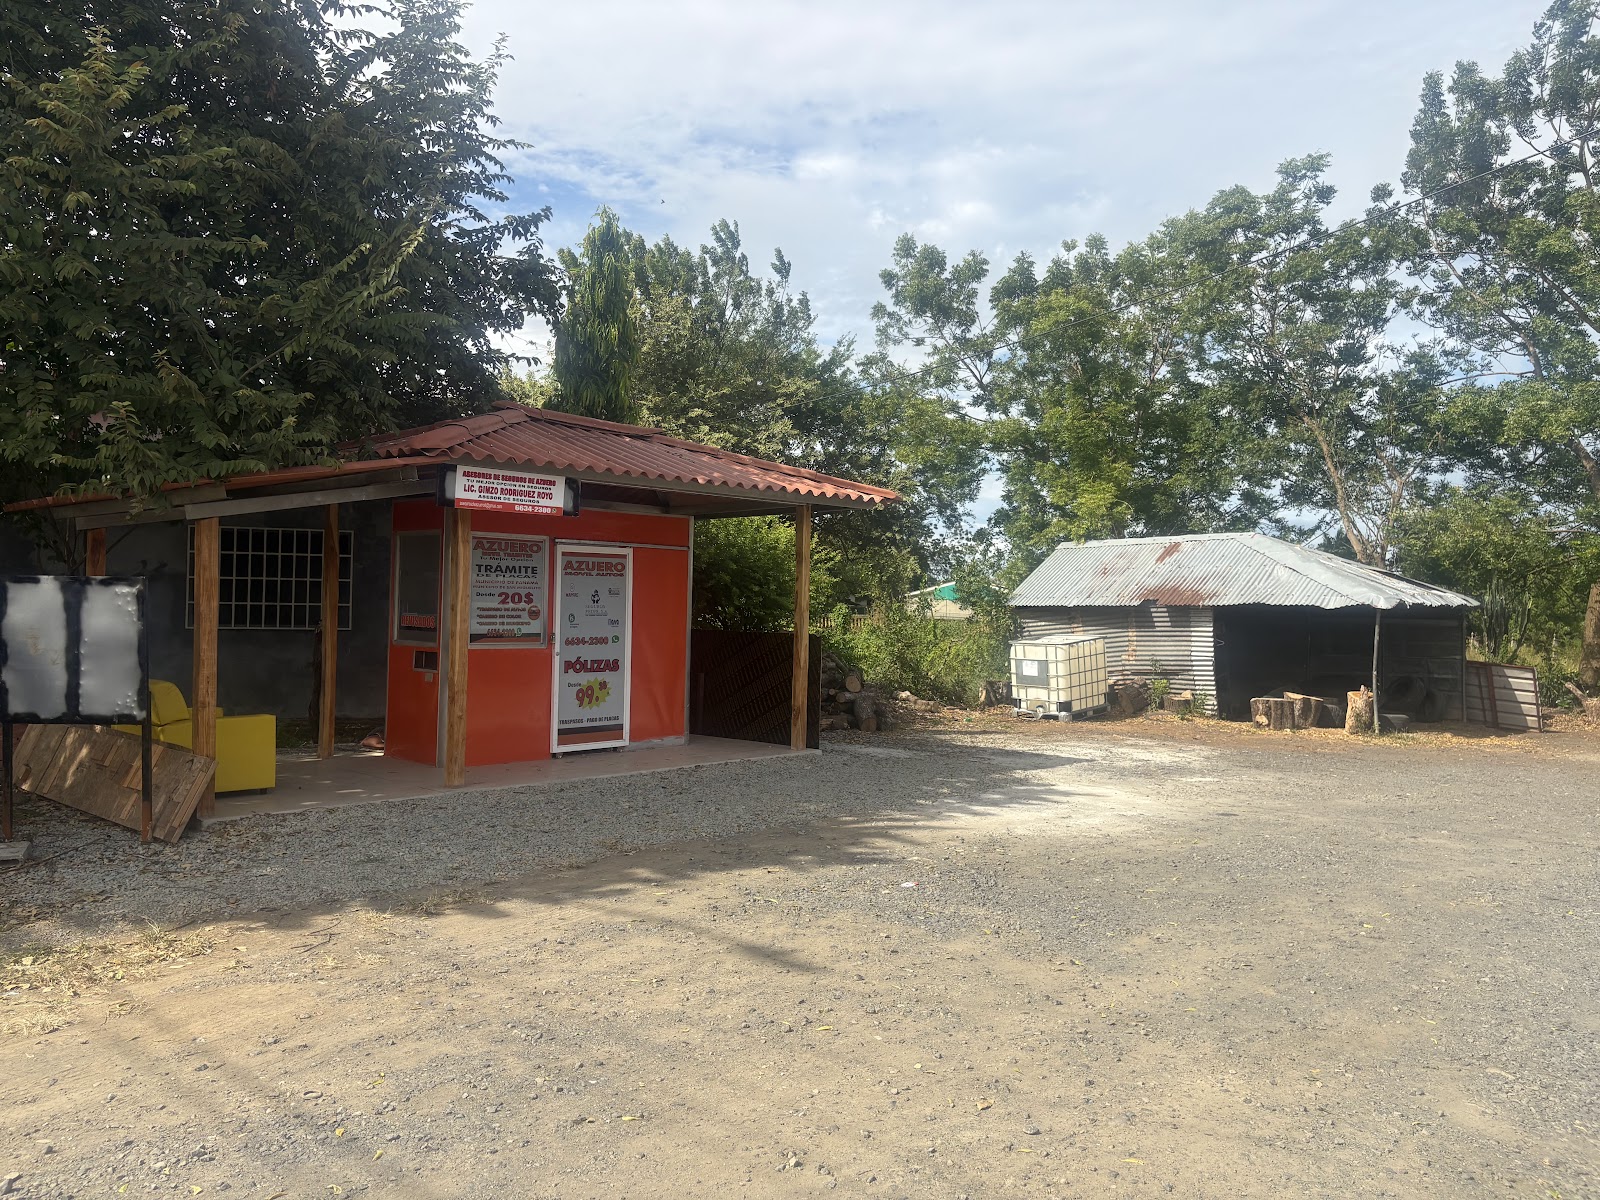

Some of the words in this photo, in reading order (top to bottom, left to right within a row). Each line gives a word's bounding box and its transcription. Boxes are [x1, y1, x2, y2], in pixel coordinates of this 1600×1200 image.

[464, 484, 476, 492] LIC.
[500, 488, 536, 498] RODRIGUEZ
[537, 492, 553, 500] ROYO
[473, 540, 541, 553] AZUERO
[476, 562, 538, 574] TRÁMITE
[563, 560, 625, 572] AZUERO
[498, 592, 534, 605] 20$
[402, 616, 434, 628] REVISADOS
[564, 656, 619, 673] PÓLIZAS
